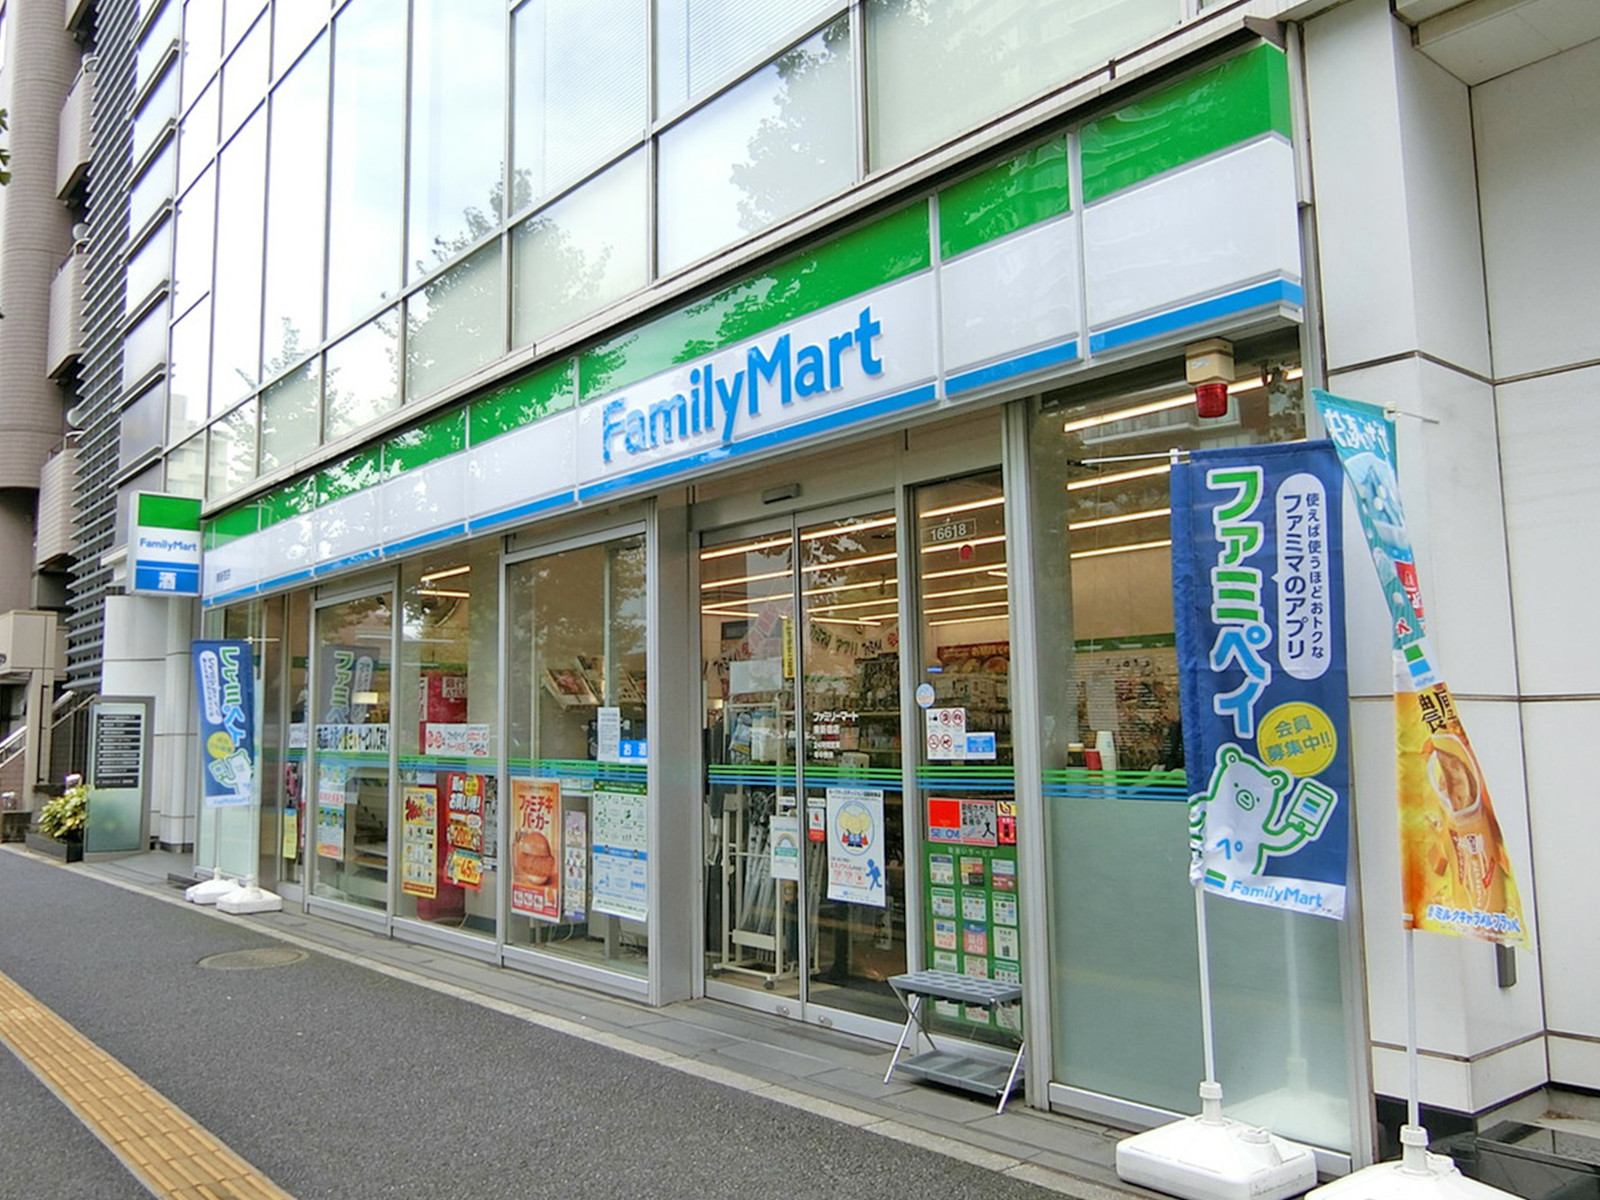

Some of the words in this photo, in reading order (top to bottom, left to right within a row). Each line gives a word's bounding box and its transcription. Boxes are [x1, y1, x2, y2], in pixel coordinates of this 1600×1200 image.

[602, 306, 884, 463] FamilyMart
[930, 523, 967, 541] 16618
[140, 537, 197, 552] FamilyMart
[158, 571, 177, 590] 酒
[1282, 494, 1308, 659] ファミマのアプリ
[1306, 492, 1325, 658] 使えば使うほどおトクな
[1208, 467, 1271, 737] ファミペイ
[813, 710, 859, 722] ファミリーマート
[1275, 715, 1313, 738] 会員
[518, 794, 554, 814] ファミチキ
[522, 811, 550, 831] バーガー
[1230, 881, 1322, 908] FamilyMart
